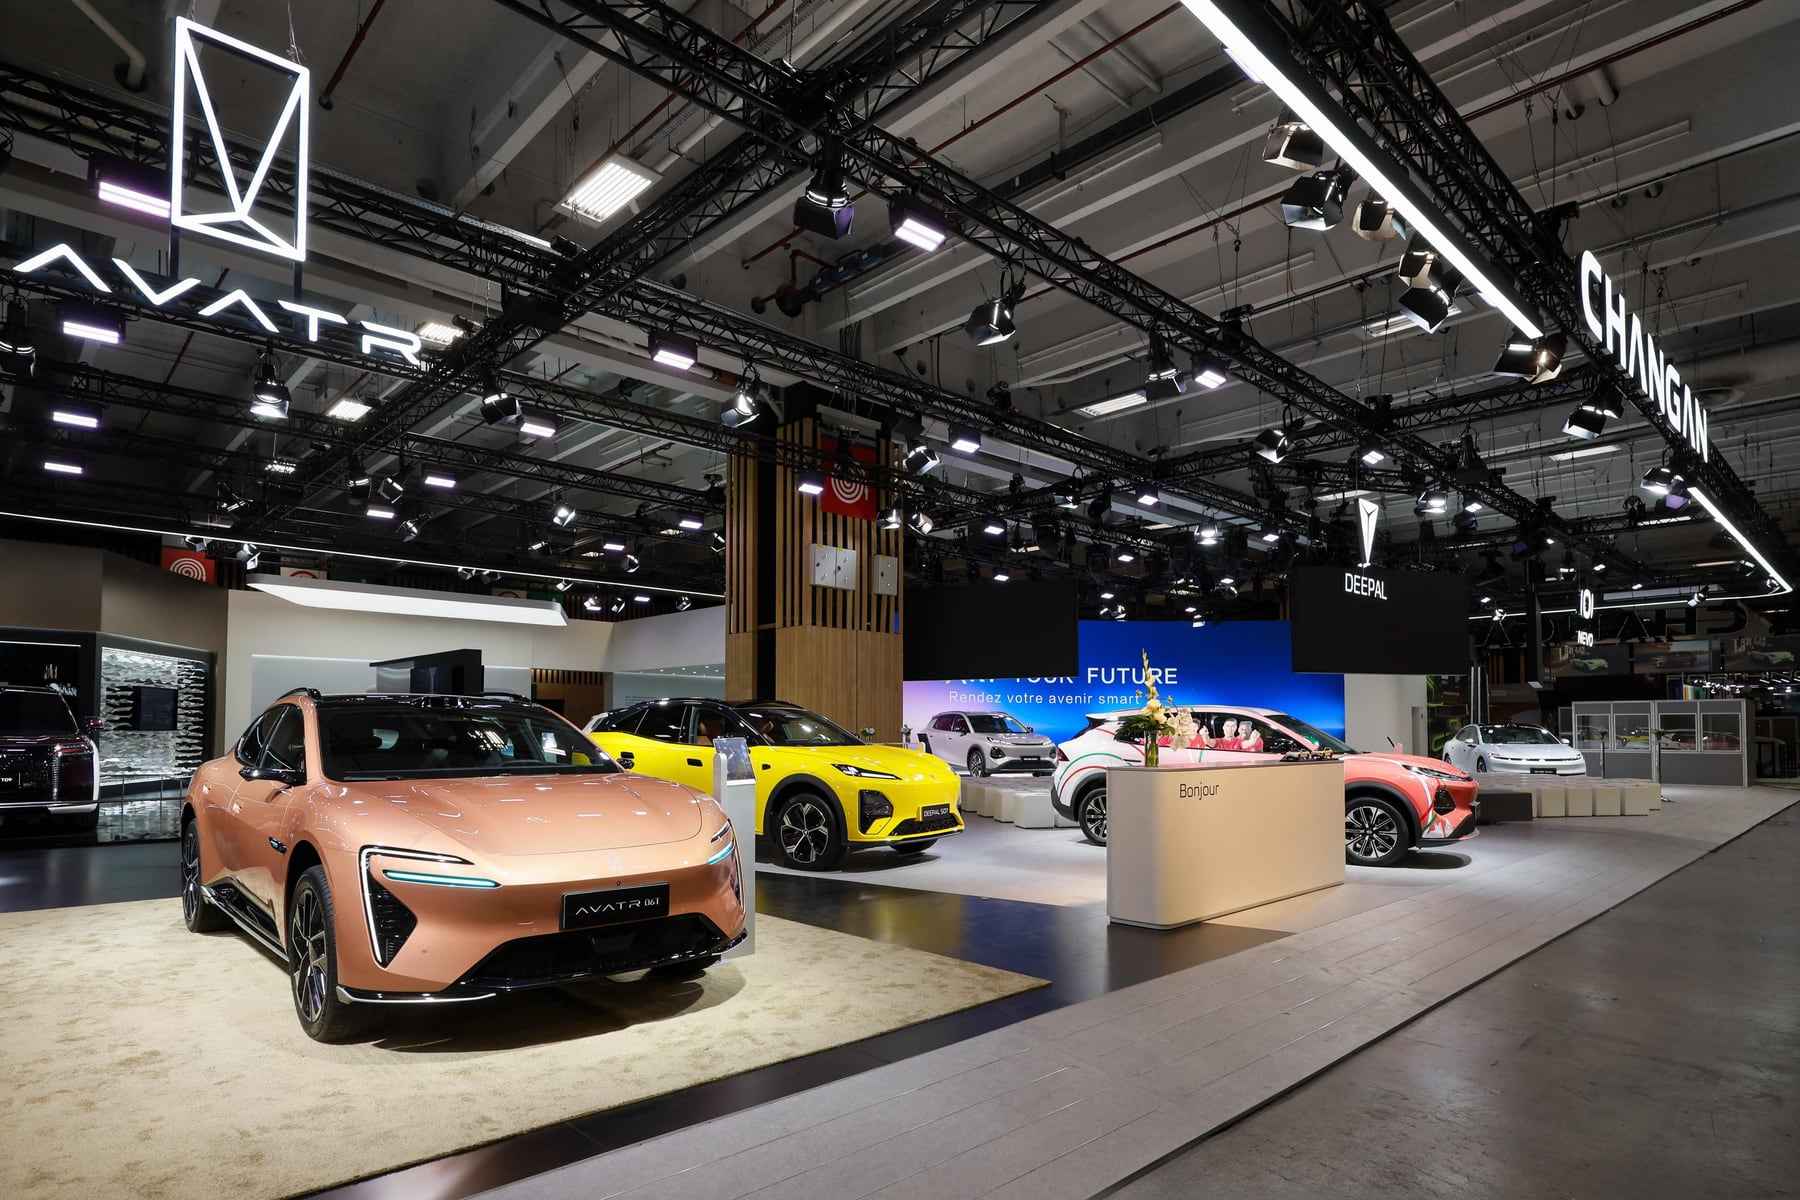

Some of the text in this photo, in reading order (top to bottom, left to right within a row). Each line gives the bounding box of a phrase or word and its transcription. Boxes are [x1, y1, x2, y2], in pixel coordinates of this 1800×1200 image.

[13, 243, 422, 364] AVATR
[1581, 249, 1708, 463] CHANGAN
[1345, 572, 1388, 600] DEEPAL
[1577, 630, 1594, 647] NEVO
[1087, 667, 1178, 684] FUTURE
[949, 691, 1141, 706] Rendez votre avenir smart
[1180, 781, 1220, 801] Bonjour
[575, 897, 661, 916] AVATR 06T
